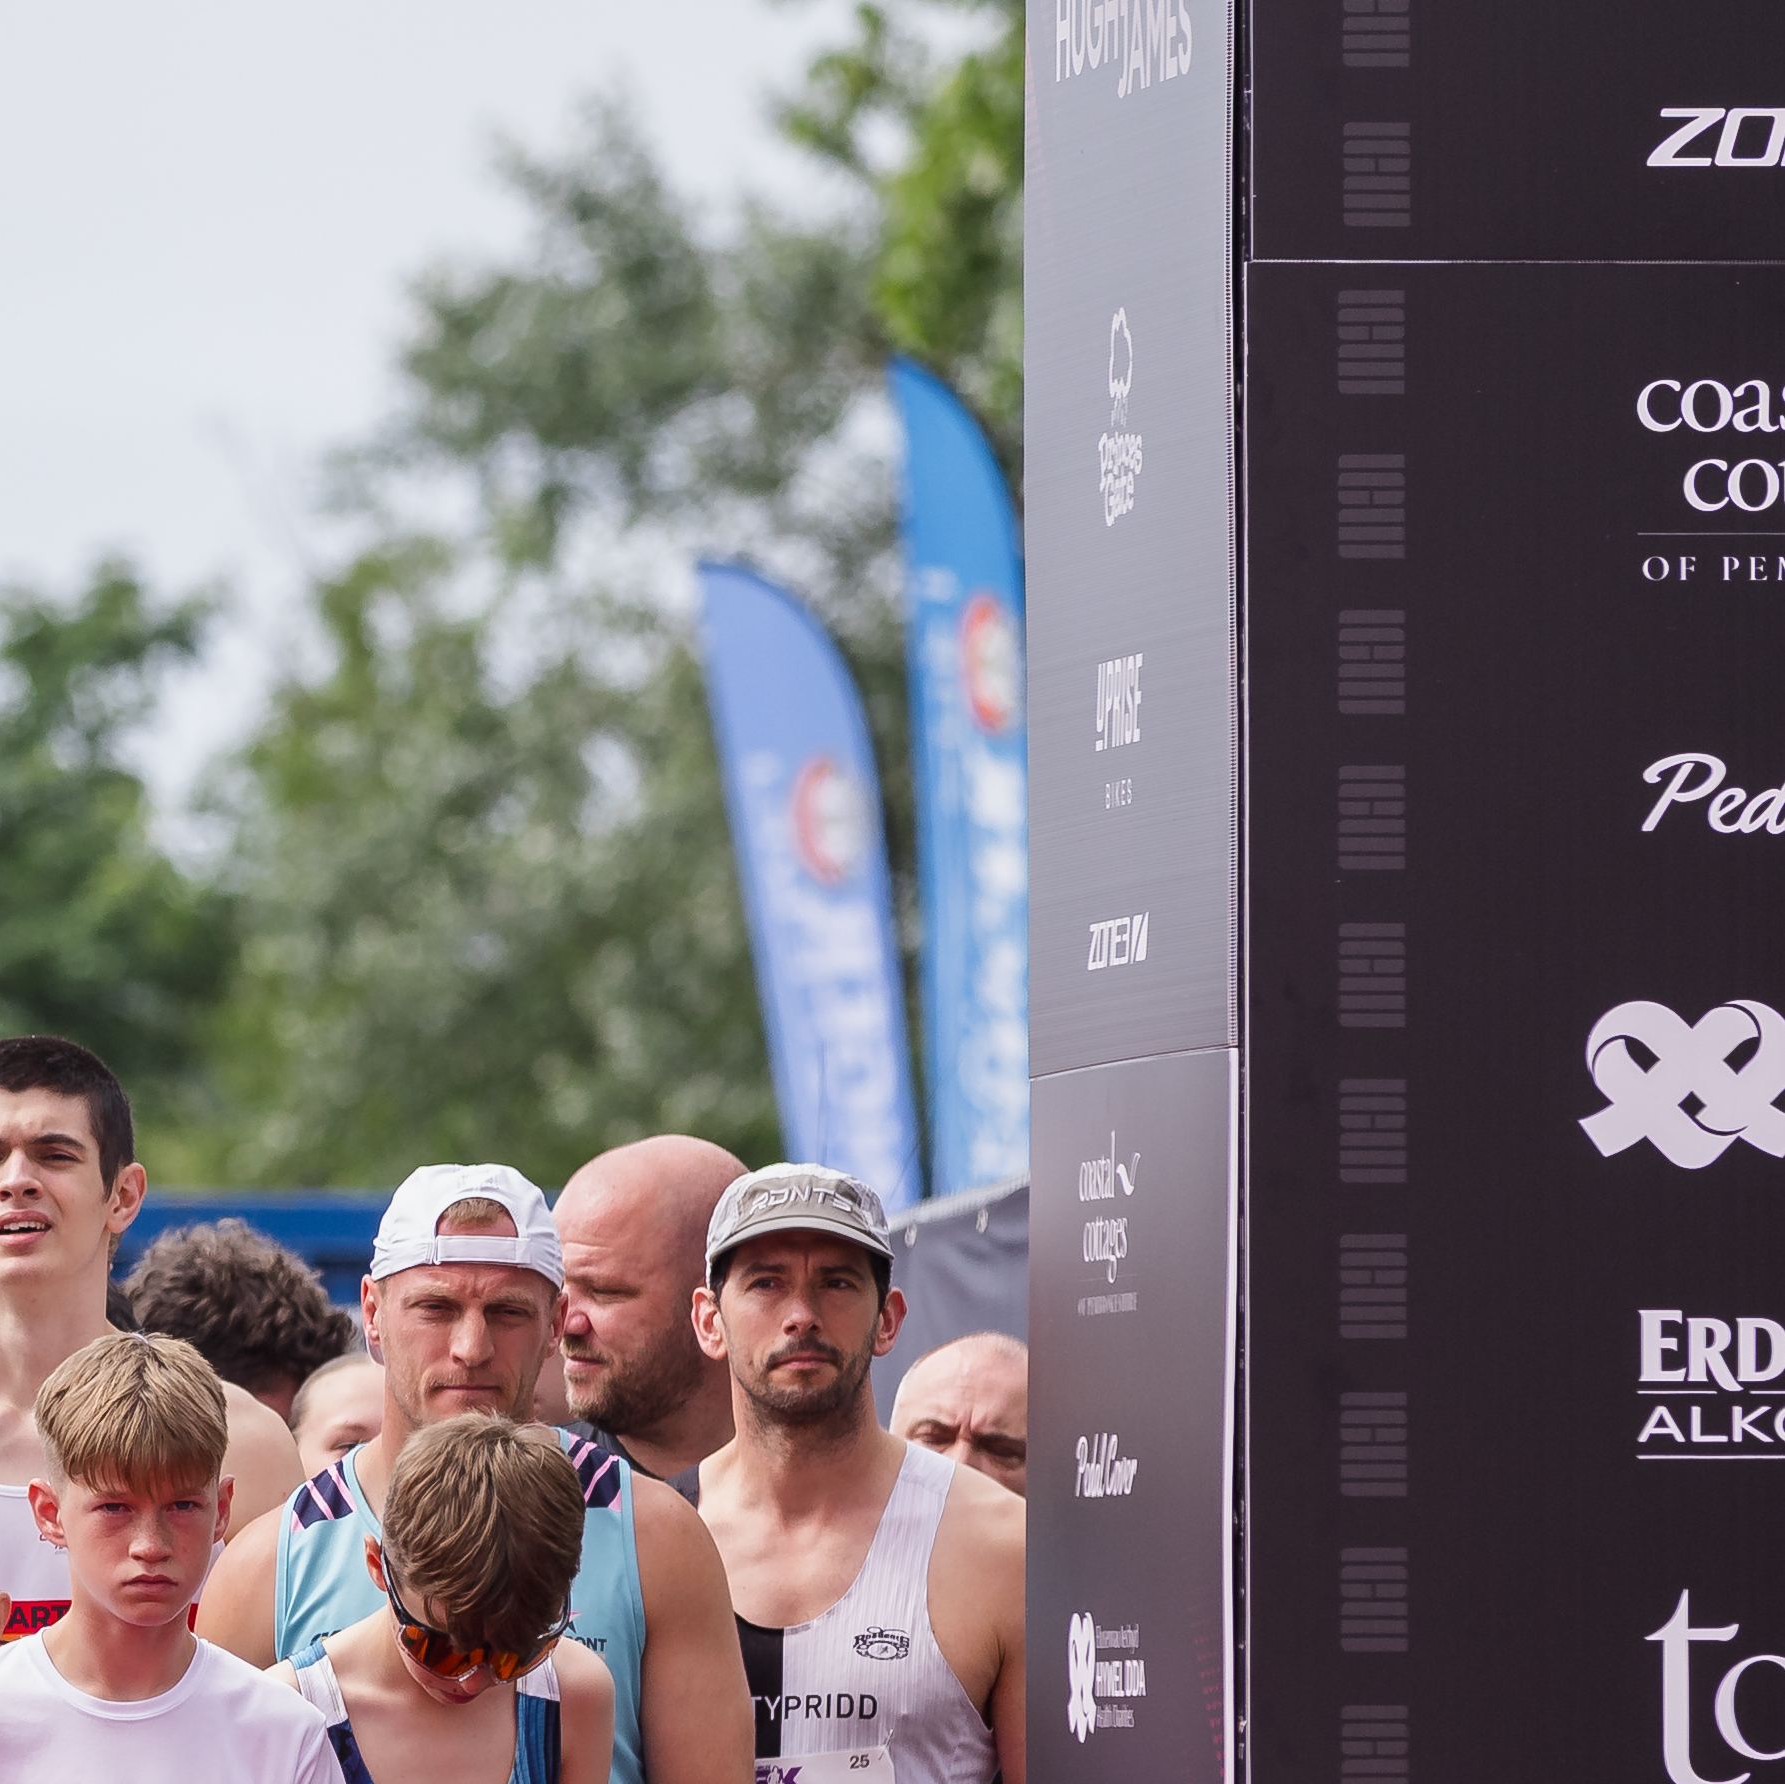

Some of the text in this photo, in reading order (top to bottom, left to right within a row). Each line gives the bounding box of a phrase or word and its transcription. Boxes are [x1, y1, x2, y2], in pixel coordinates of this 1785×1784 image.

[1117, 0, 1192, 99] JAMES
[1647, 107, 1785, 167] ZO
[1636, 379, 1785, 433] coa
[1683, 458, 1785, 512] co
[1642, 555, 1785, 581] OF PE
[1095, 653, 1144, 751] UPRISE
[1105, 777, 1133, 809] BIKES
[1637, 1405, 1785, 1443] ALK
[849, 1754, 870, 1770] 25
